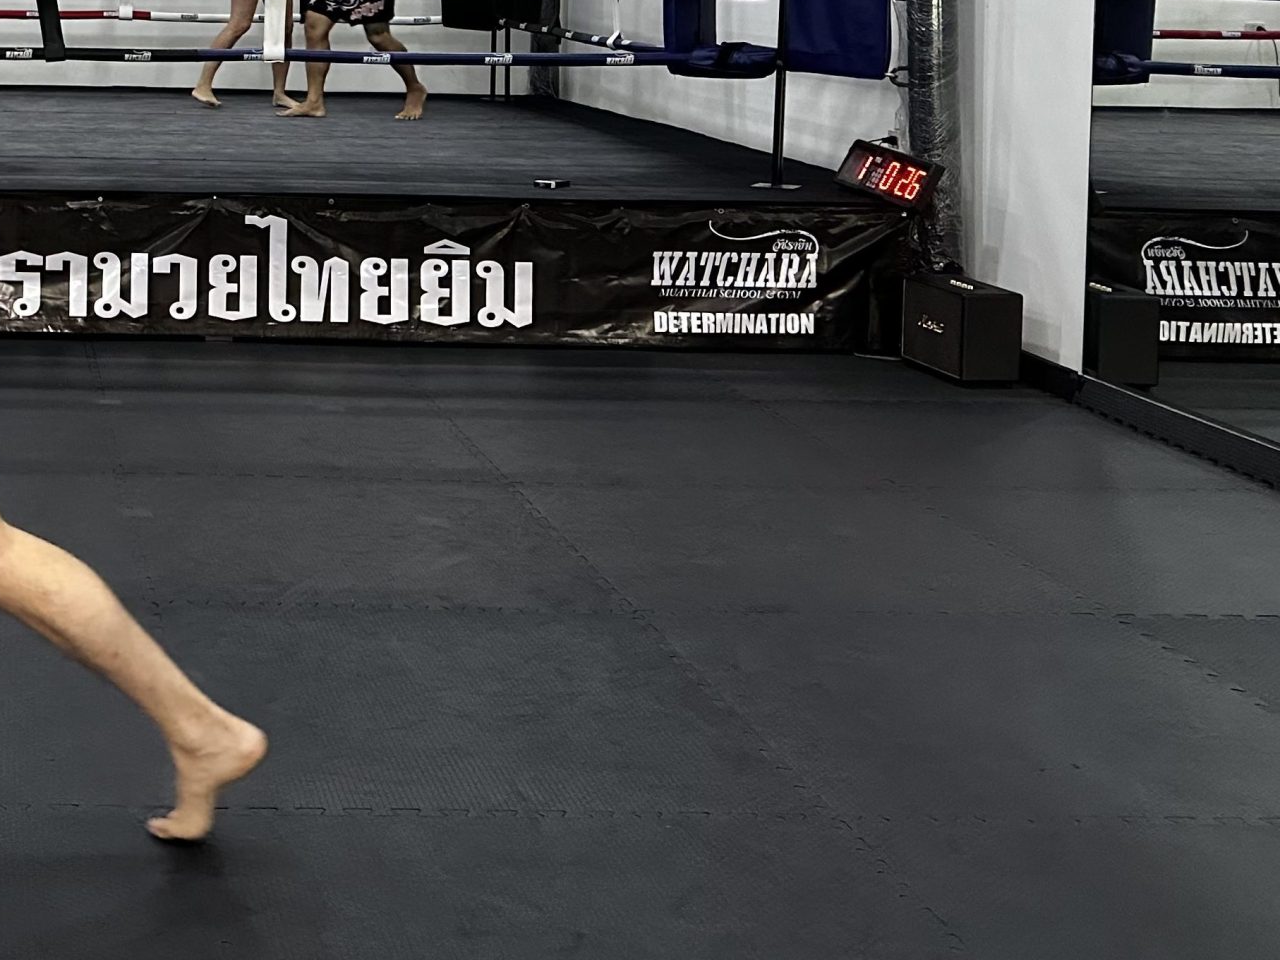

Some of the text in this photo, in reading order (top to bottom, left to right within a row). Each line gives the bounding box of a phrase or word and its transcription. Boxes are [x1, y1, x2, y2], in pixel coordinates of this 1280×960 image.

[650, 251, 818, 288] WATCHARA
[658, 287, 717, 299] MUAYTHAI
[719, 289, 765, 299] SCHOOL
[777, 290, 802, 300] GYM
[653, 311, 815, 335] DETERMINATION
